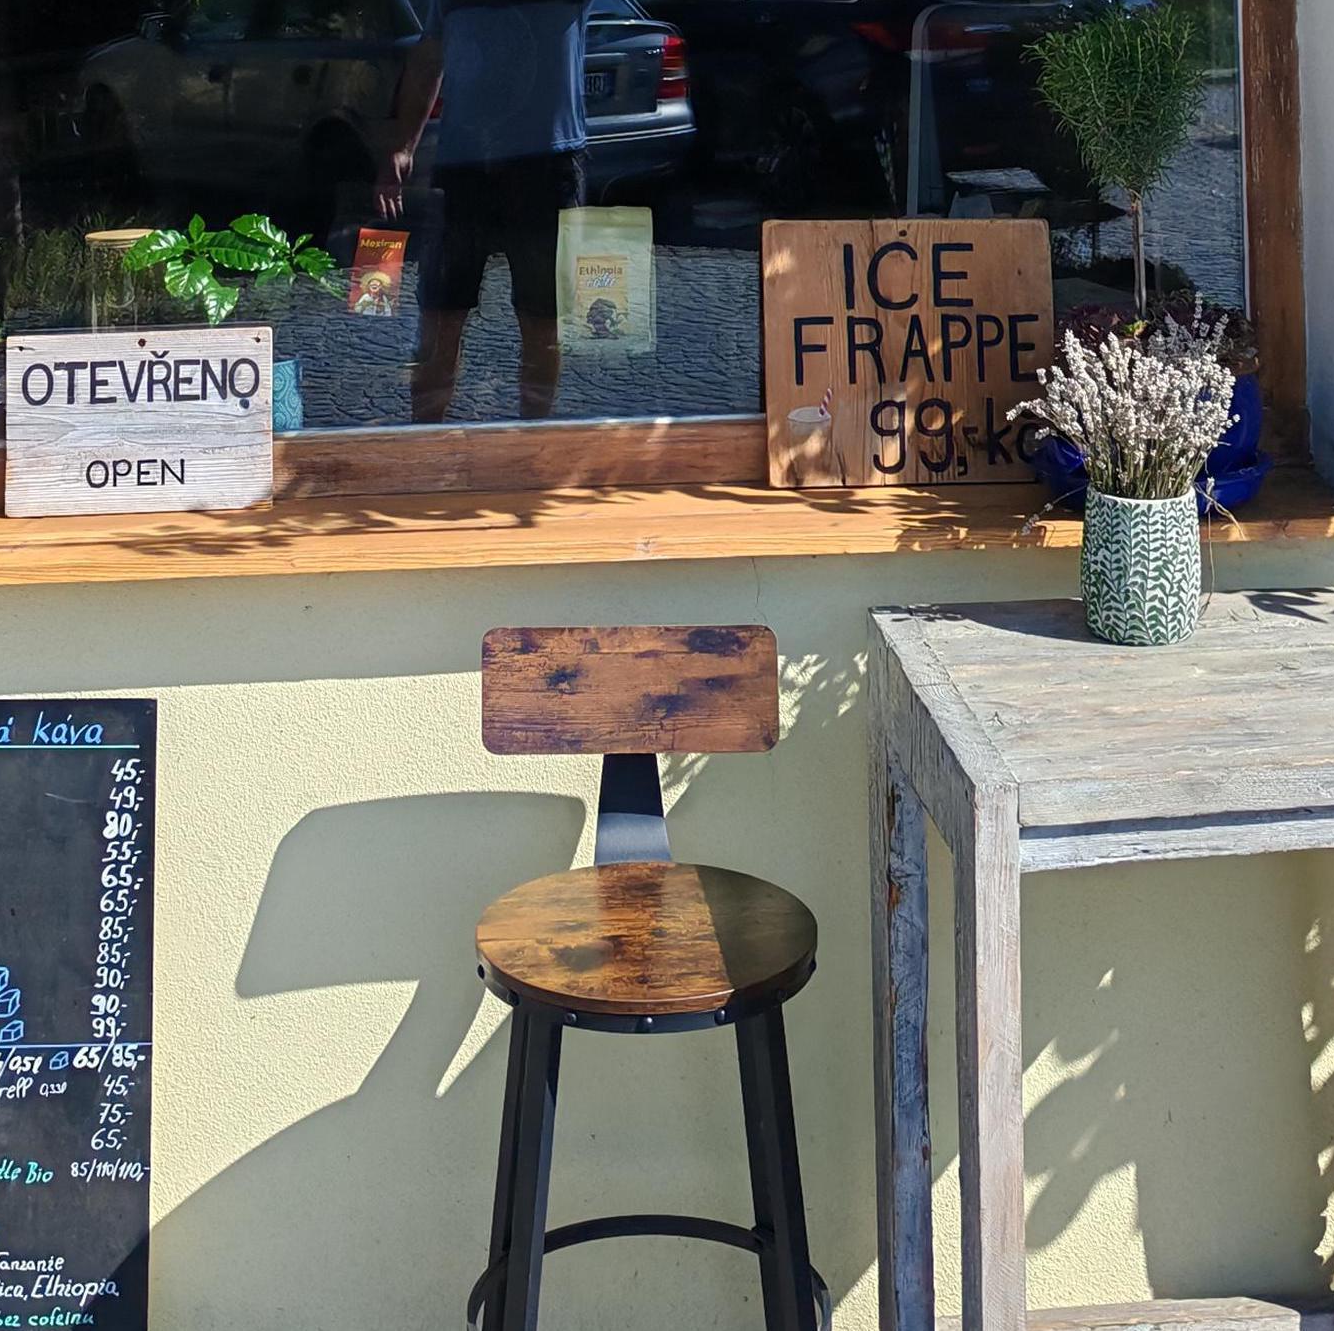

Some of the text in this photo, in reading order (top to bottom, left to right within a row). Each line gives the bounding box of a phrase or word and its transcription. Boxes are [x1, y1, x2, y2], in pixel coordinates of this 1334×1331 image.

[843, 242, 974, 311] ICE
[792, 314, 1040, 387] FRAPPE
[21, 350, 261, 407] OTEVŘENO
[85, 458, 186, 488] OPEN
[32, 711, 104, 745] káva
[24, 1161, 54, 1185] Bio
